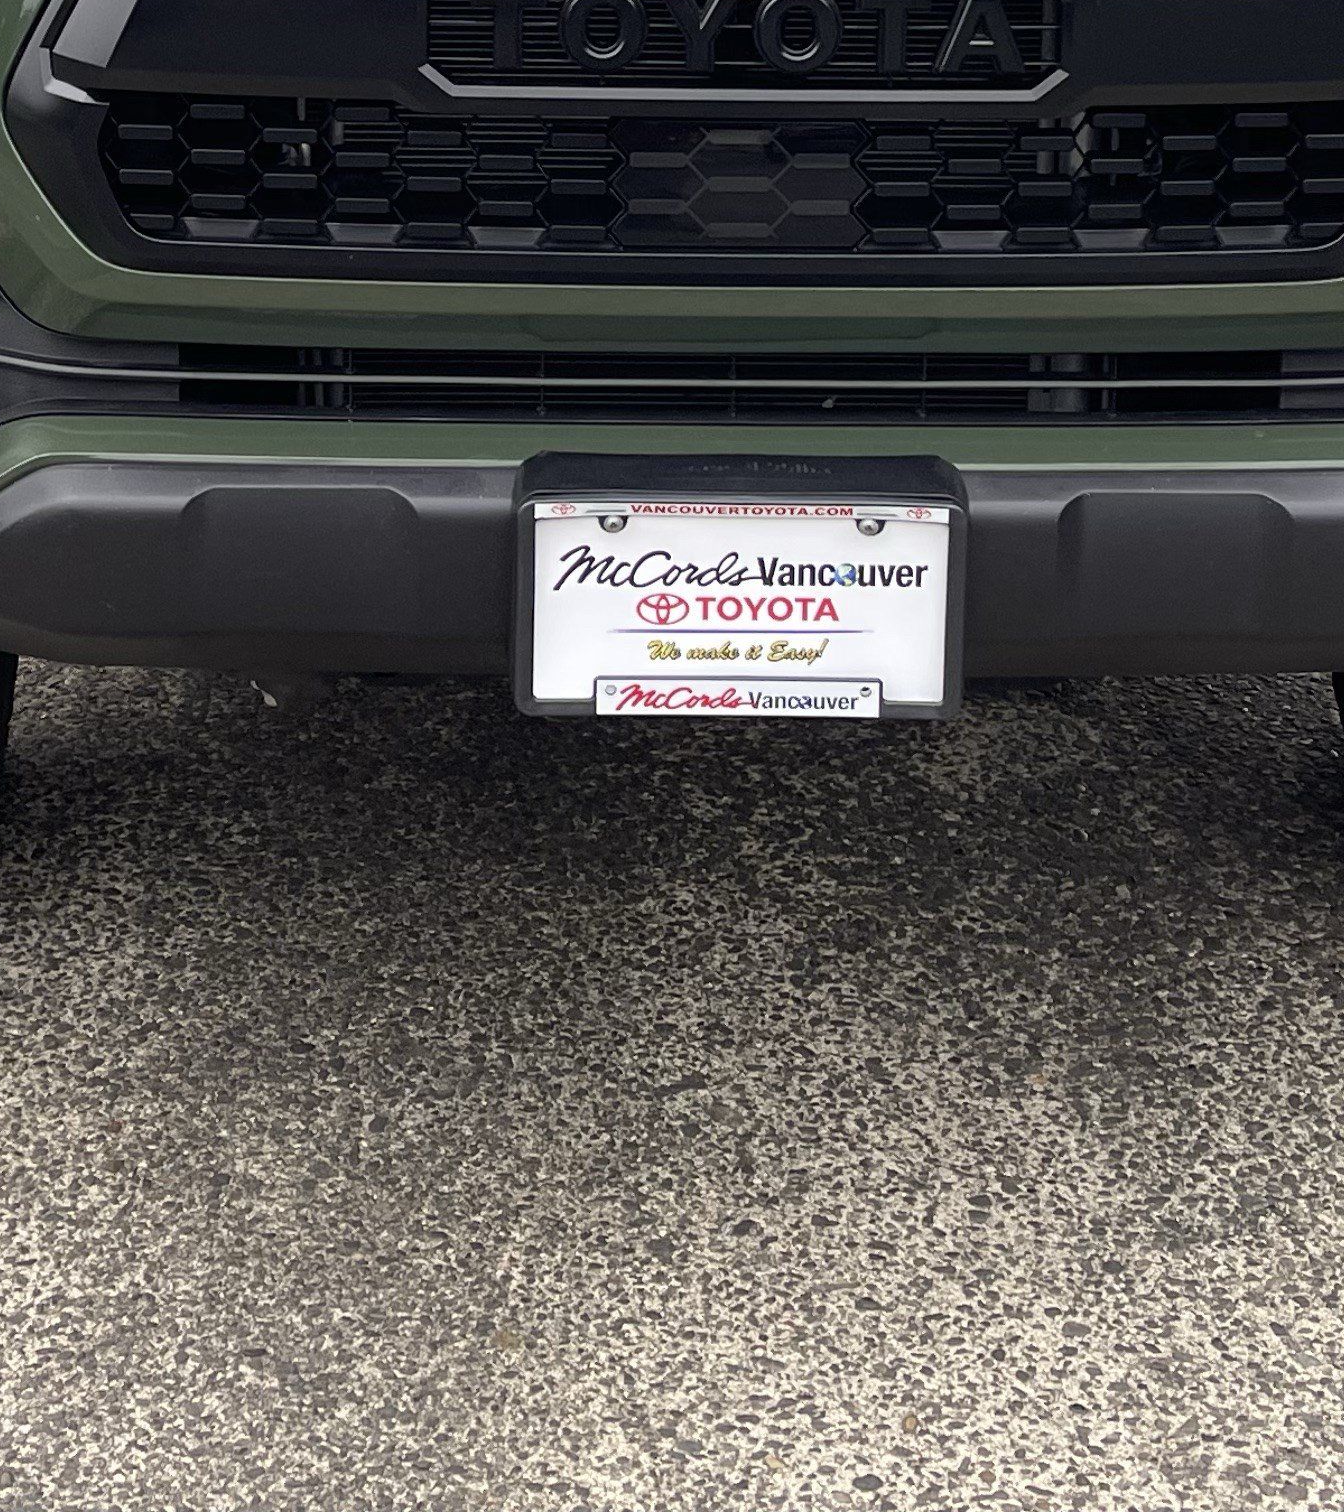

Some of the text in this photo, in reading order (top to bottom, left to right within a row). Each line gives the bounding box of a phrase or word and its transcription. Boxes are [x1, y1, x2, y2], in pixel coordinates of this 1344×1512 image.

[630, 504, 854, 516] VANCOUVERTOYOTA.COM
[695, 596, 840, 622] TOYOTA
[647, 638, 830, 666] We make it Easy!
